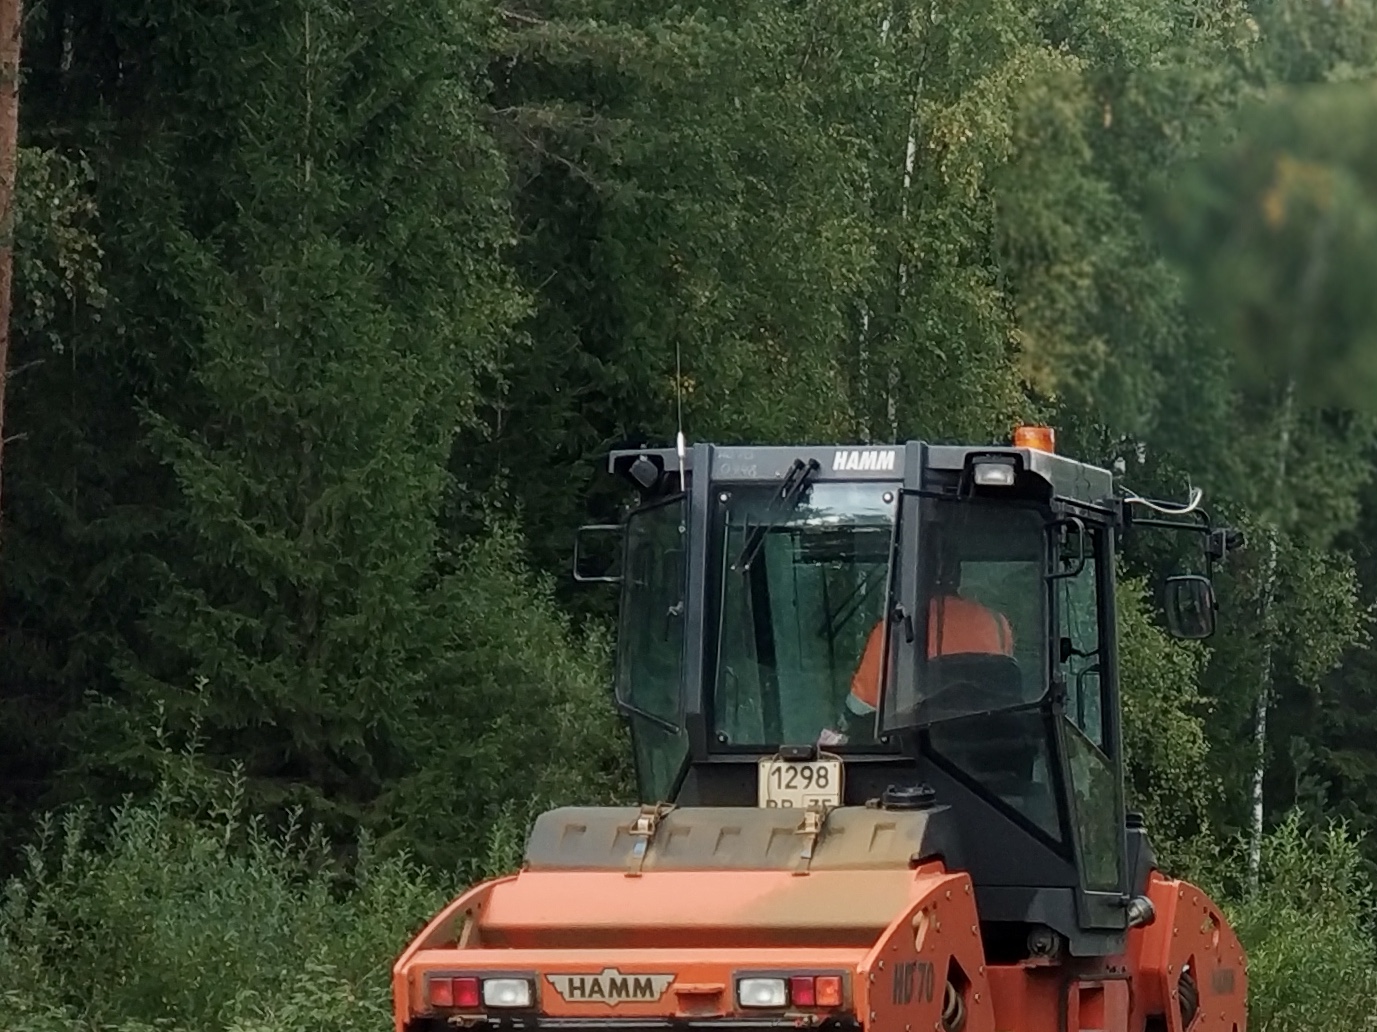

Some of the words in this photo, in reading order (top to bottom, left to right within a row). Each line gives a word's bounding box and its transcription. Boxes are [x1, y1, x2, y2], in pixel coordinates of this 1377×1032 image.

[832, 450, 895, 471] HAMM
[771, 765, 829, 790] 1298
[567, 977, 655, 999] HAMM
[892, 961, 914, 1005] HD
[916, 961, 935, 1004] 70
